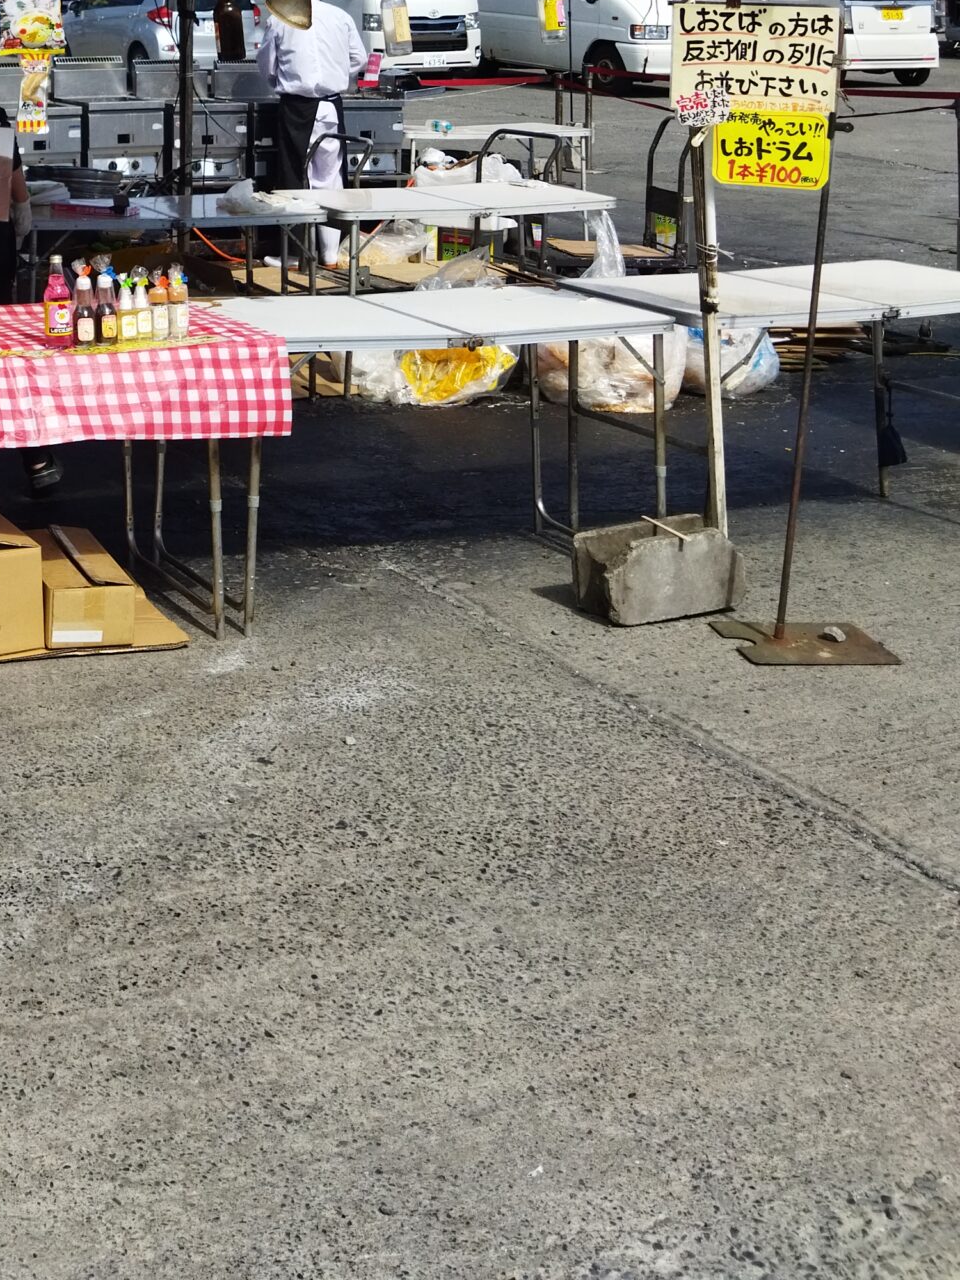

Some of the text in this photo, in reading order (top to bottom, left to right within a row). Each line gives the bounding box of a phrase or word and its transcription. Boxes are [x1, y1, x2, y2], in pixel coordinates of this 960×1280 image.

[682, 39, 835, 67] 反対側の列に
[695, 70, 829, 97] お並び下さい。
[676, 92, 709, 113] 完売
[720, 137, 814, 162] しおドラム
